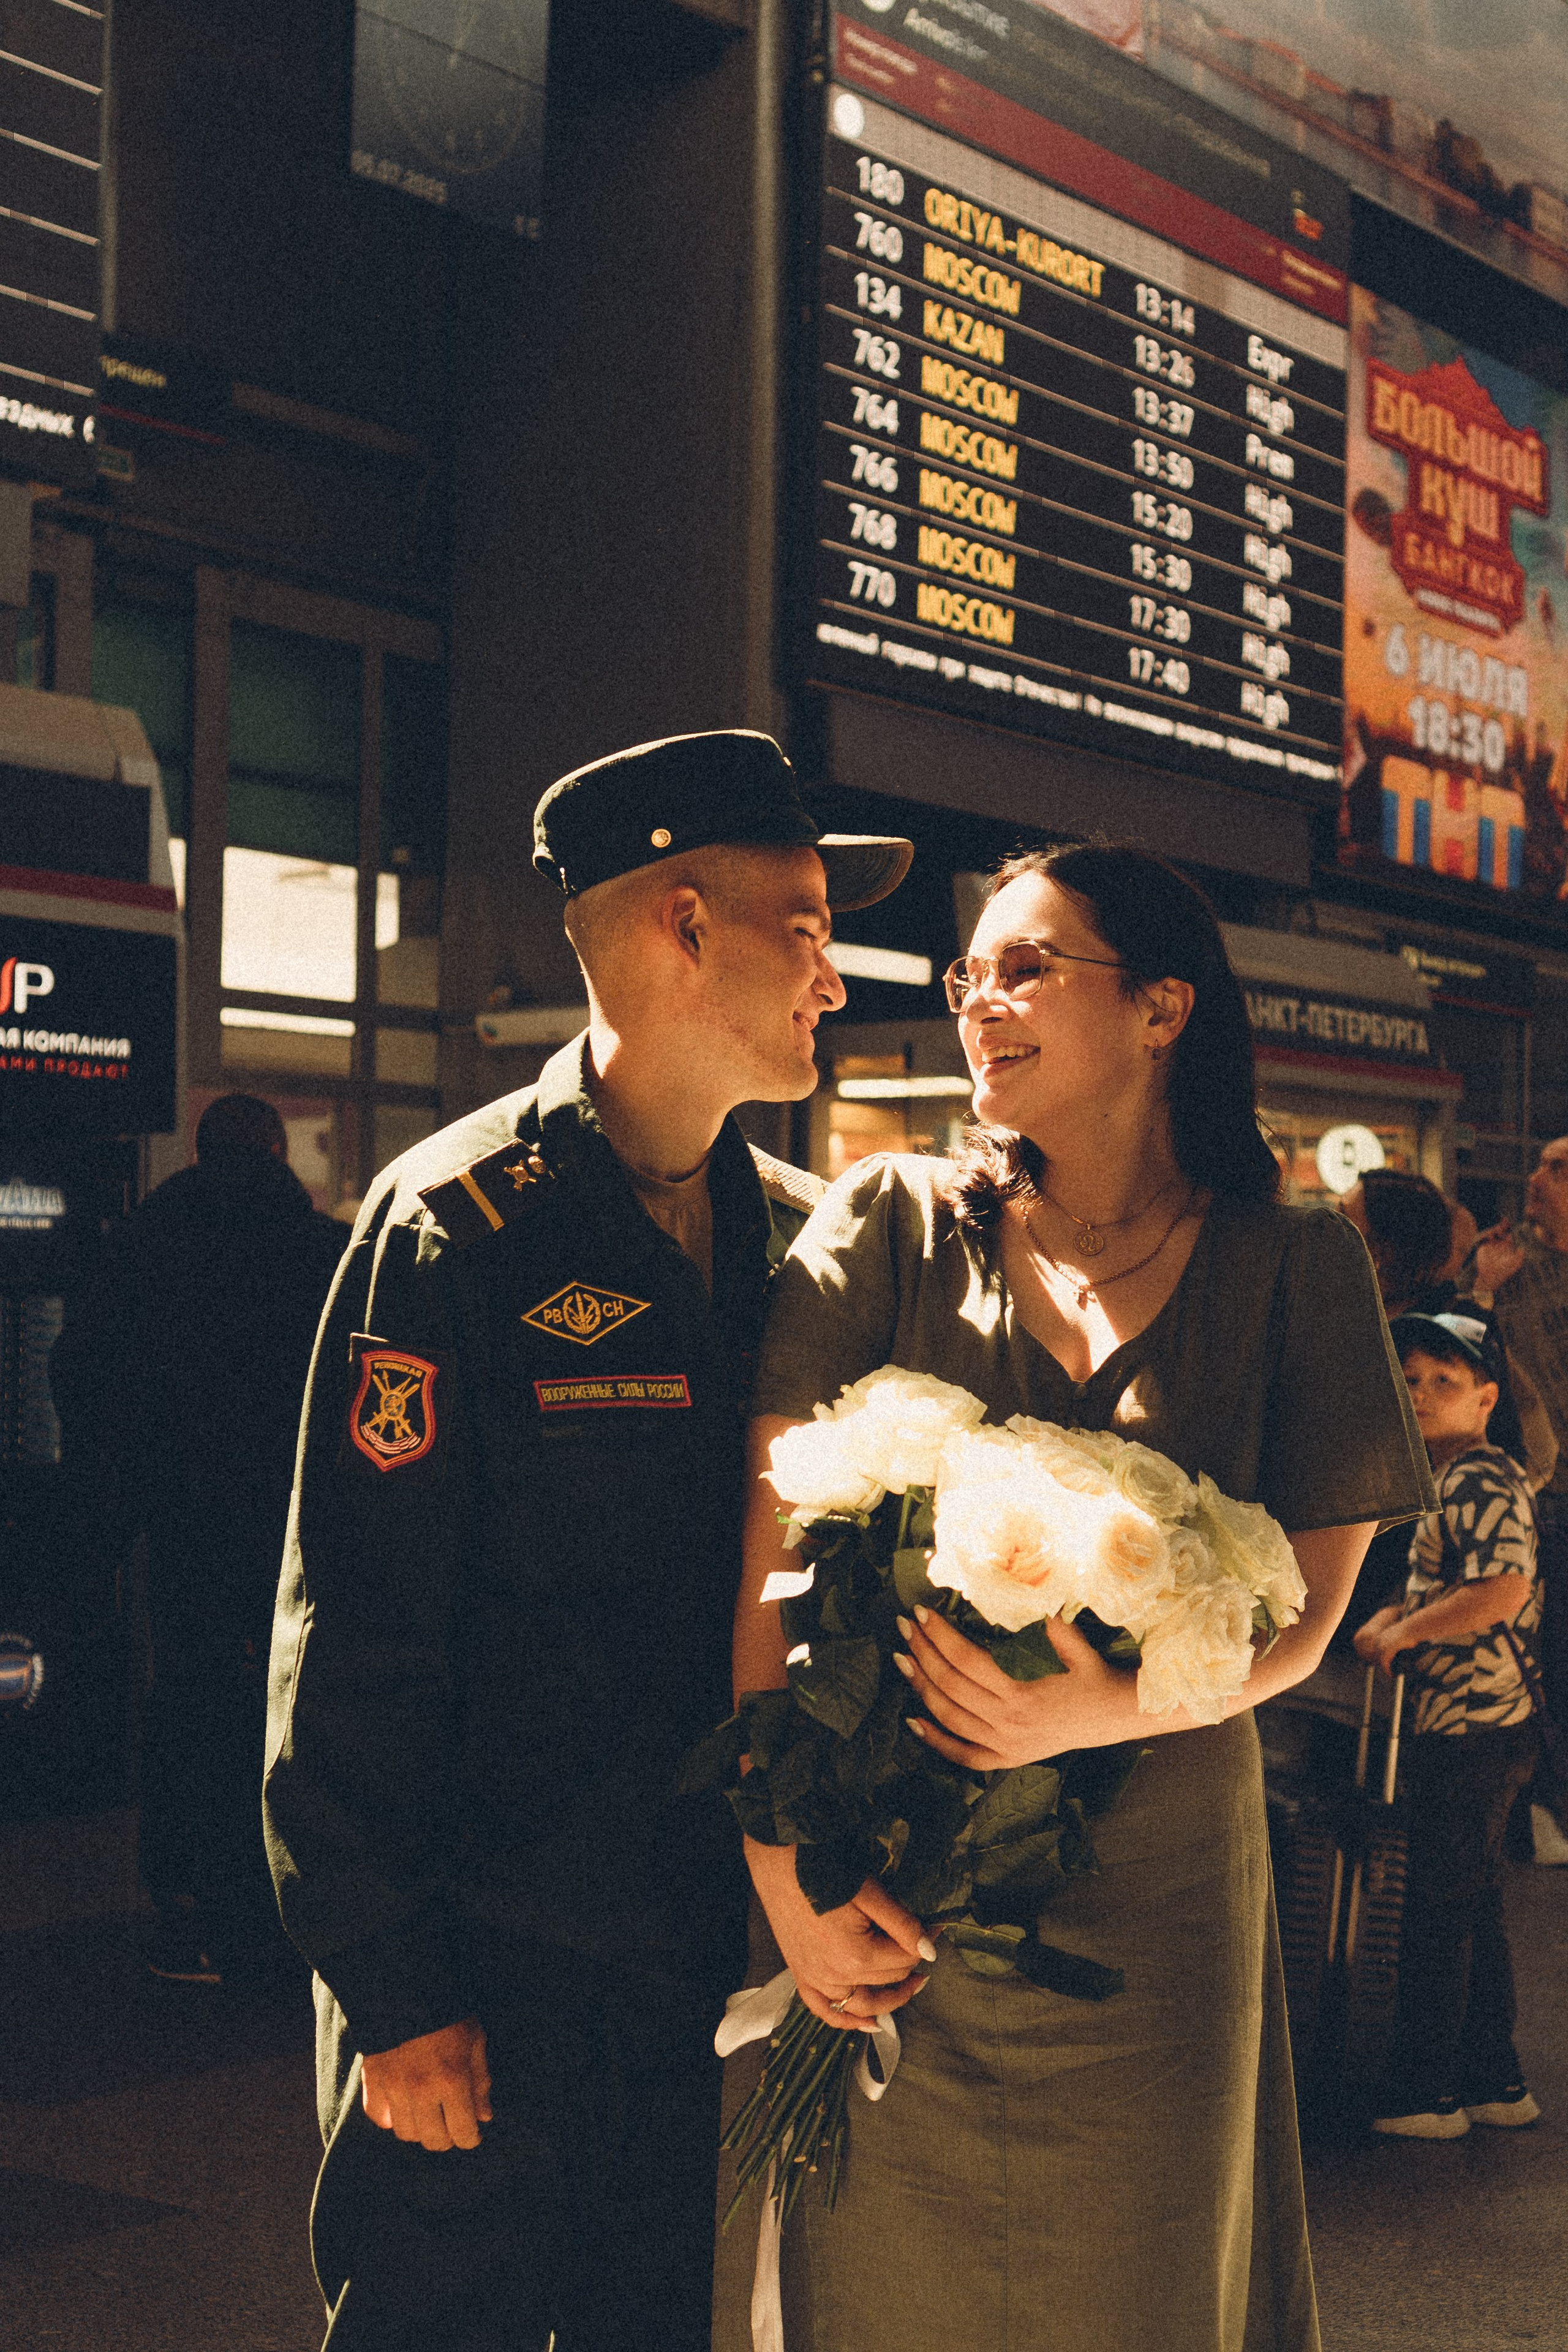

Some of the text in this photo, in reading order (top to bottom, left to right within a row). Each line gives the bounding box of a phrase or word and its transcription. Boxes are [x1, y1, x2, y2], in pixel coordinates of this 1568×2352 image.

[854, 212, 903, 262] 760
[923, 242, 1022, 315] MOSCOW
[1133, 334, 1195, 388] 13:26
[856, 156, 905, 205] 180
[1134, 282, 1195, 336] 13:14
[853, 328, 900, 379] 762
[921, 355, 1019, 425] MOSCOW
[1132, 439, 1194, 490] 13:50
[854, 272, 902, 320] 134
[923, 299, 1005, 365] KAZAN
[1133, 386, 1194, 437] 13:37
[852, 386, 899, 435] 764
[920, 412, 1018, 481] MOSCOW
[1131, 491, 1193, 541] 15:20
[1371, 375, 1545, 505] БОЛЬШОЙ
[1420, 459, 1502, 548] КУШ
[849, 503, 897, 550] 768
[918, 526, 1016, 590] MOSCOW
[1129, 595, 1191, 643] 17:30
[850, 445, 899, 492] 766
[919, 469, 1017, 535] MOSCOW
[1130, 543, 1192, 592] 15:30
[848, 561, 896, 607] 770
[916, 582, 1015, 645] MOSCOW
[1128, 647, 1190, 695] 17:40
[1384, 622, 1529, 718] 6 ИЮЛЯ
[1408, 693, 1506, 773] 18:30
[23, 1029, 131, 1059] КОМПАНИЯ
[543, 1300, 624, 1324] РВ СН
[541, 1382, 684, 1402] ВООРУЖЕННЫЕ СИЛЫ РОССИИ
